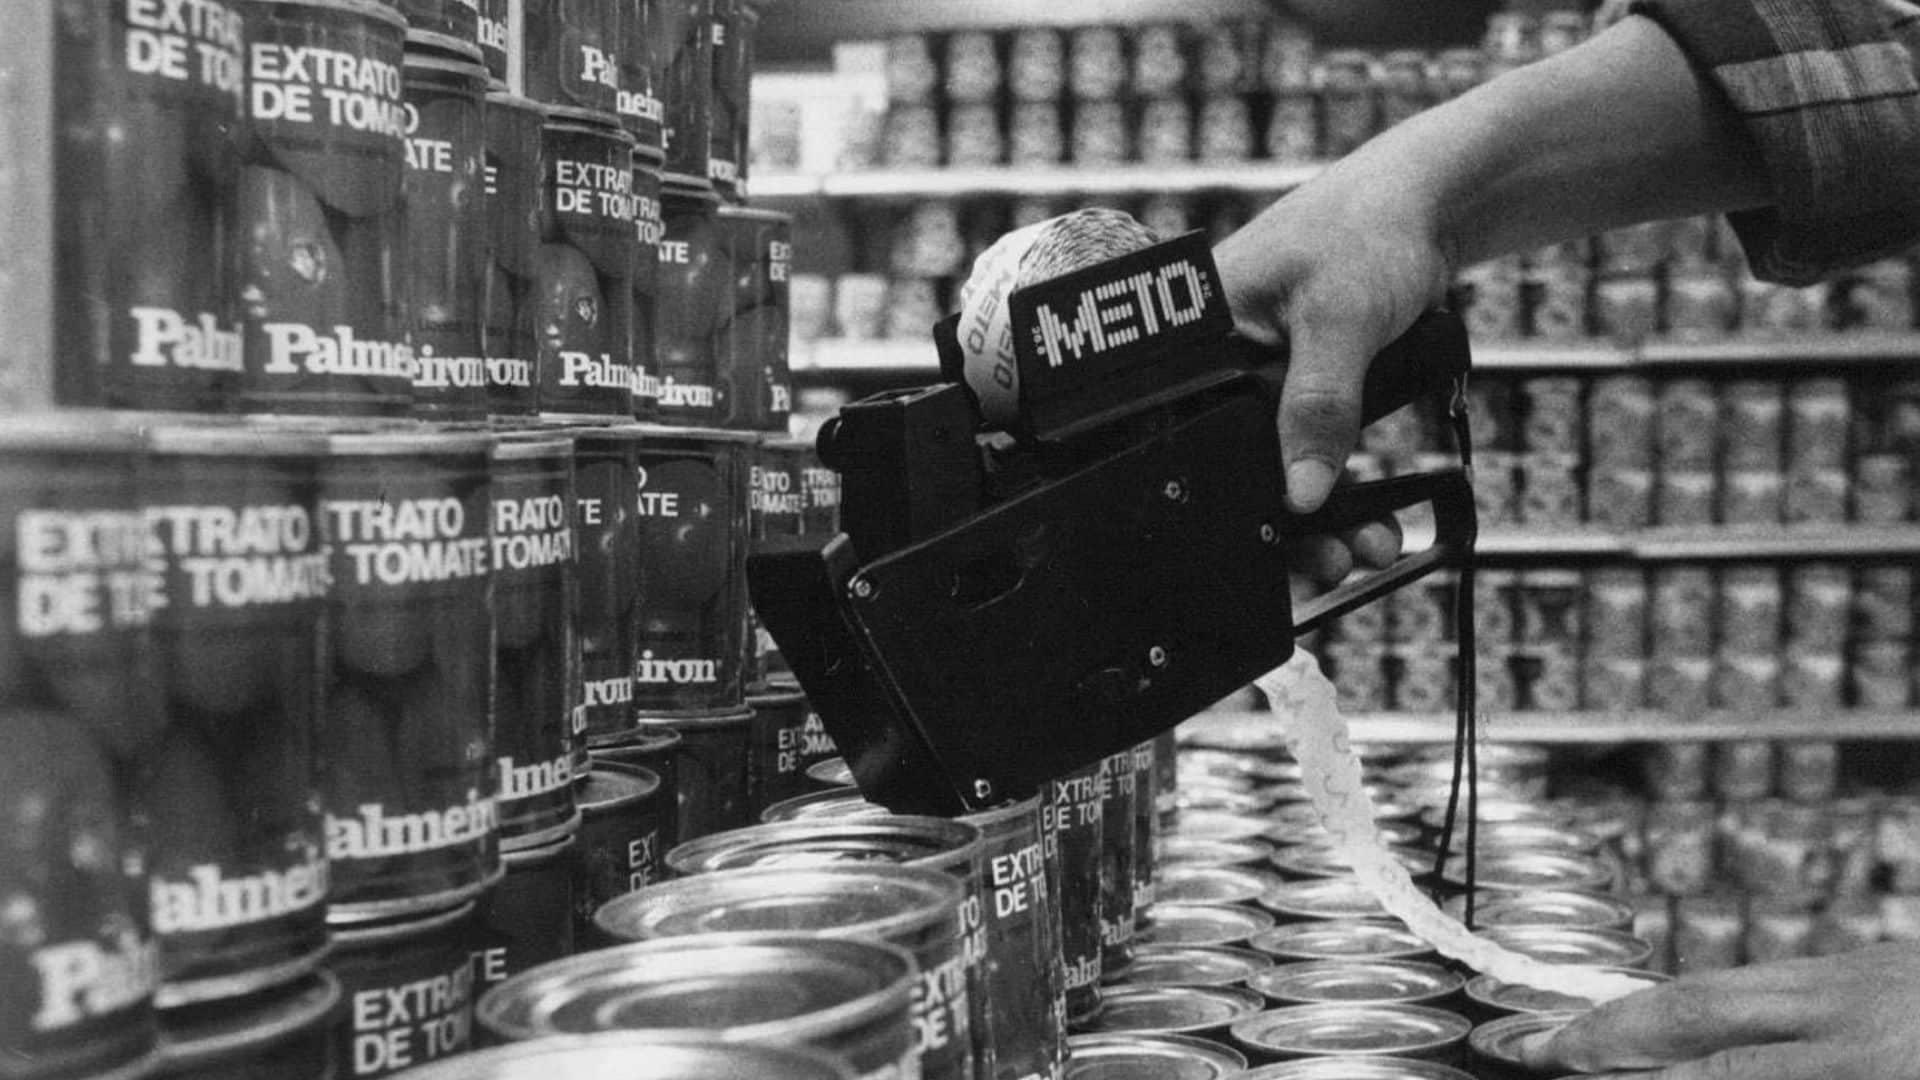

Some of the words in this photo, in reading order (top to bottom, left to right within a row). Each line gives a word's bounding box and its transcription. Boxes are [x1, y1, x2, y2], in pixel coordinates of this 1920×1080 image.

[126, 29, 188, 80] DE
[251, 43, 400, 100] EXTRATO
[252, 82, 313, 123] DE
[556, 187, 592, 214] DE
[1036, 259, 1205, 368] METO
[345, 542, 488, 585] TOMATE
[995, 881, 1028, 918] DE
[354, 1026, 412, 1075] DE
